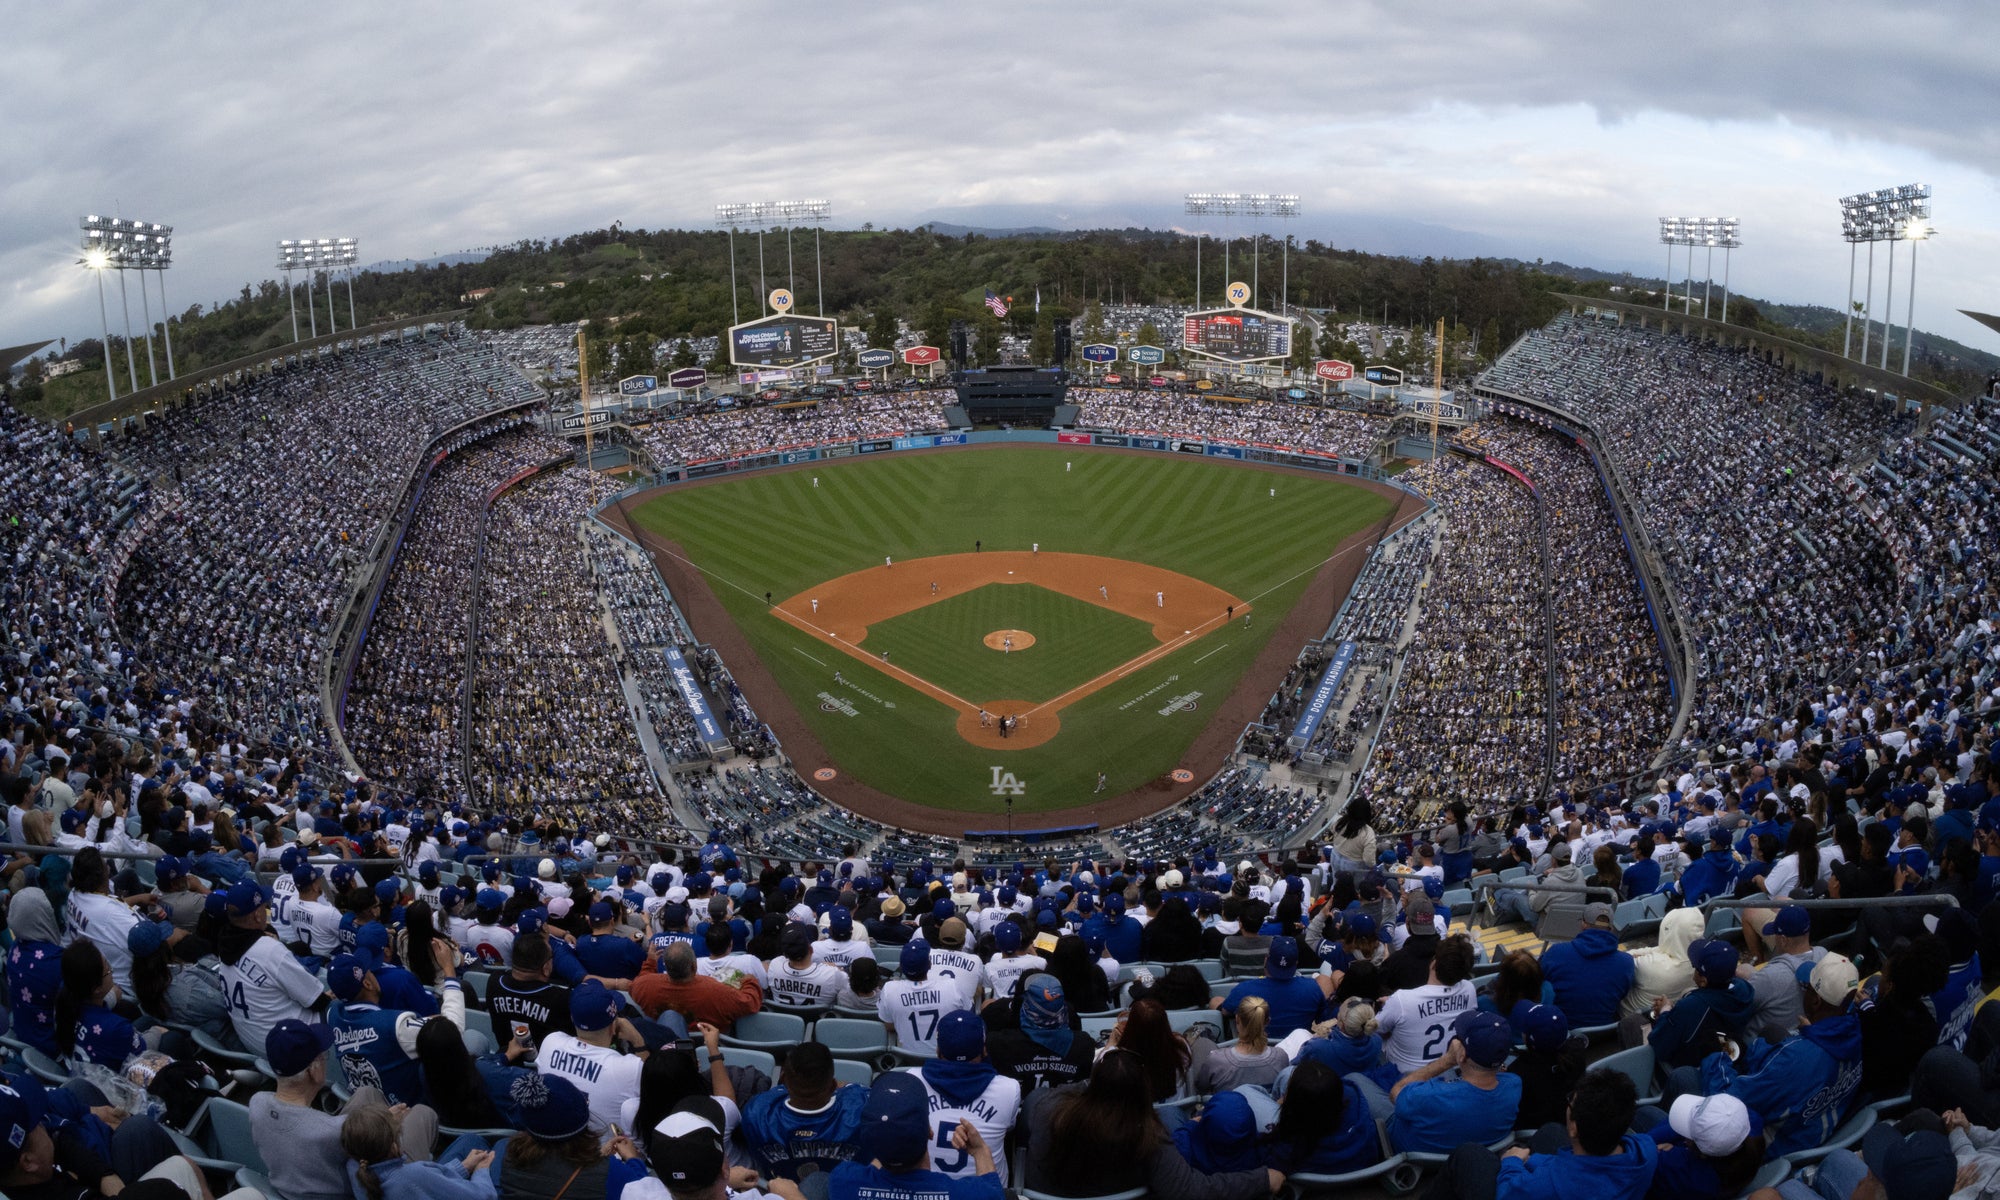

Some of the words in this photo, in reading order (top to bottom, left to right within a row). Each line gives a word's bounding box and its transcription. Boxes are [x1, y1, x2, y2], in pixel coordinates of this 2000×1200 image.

[776, 295, 788, 305] 76
[1232, 289, 1244, 298] 76
[861, 355, 890, 363] Spectrum
[623, 381, 644, 390] blue
[1382, 373, 1400, 381] Health
[1310, 686, 1331, 713] DODGER
[1325, 660, 1344, 686] STADIUM
[988, 766, 1026, 795] LA
[292, 910, 314, 926] OHTANI
[655, 935, 693, 947] FREEMAN
[773, 978, 822, 997] CABRERA
[900, 990, 940, 1007] OHTANI
[1417, 994, 1470, 1019] KERSHAW
[493, 996, 550, 1023] FREEMAN
[908, 1009, 940, 1041] 17
[333, 1026, 379, 1052] Dodgers
[550, 1049, 602, 1083] OHTANI
[1014, 1062, 1048, 1072] WORLD
[1049, 1063, 1078, 1074] SERIES
[1802, 1060, 1863, 1124] Dodgers
[934, 1120, 969, 1173] 5
[858, 1190, 872, 1198] LOS
[875, 1191, 910, 1200] ANGELES
